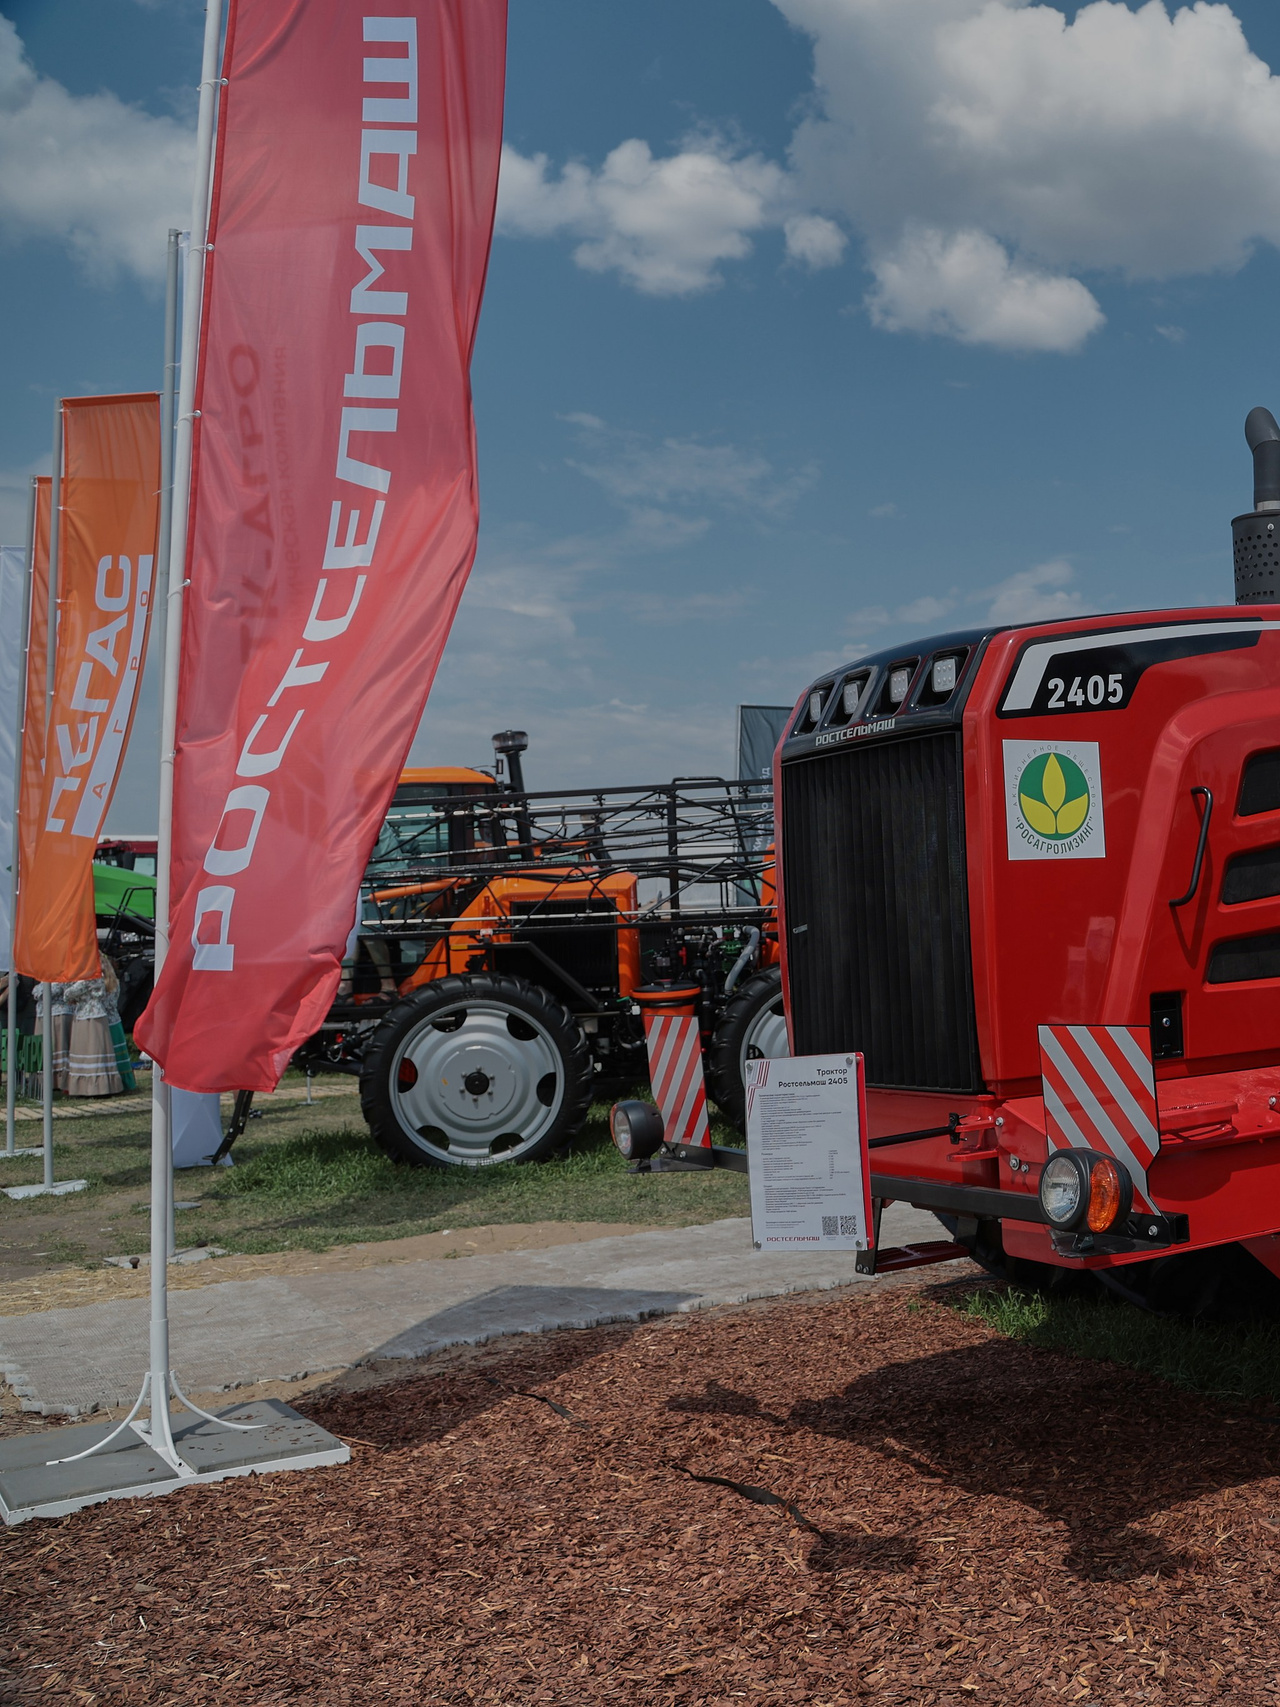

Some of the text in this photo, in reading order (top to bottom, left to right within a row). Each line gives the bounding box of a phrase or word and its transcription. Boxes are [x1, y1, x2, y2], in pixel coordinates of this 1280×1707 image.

[192, 16, 418, 972] РОСТСЕЛЬМАШ
[45, 555, 131, 833] ПЕГАС
[1047, 673, 1123, 709] 2405
[815, 718, 896, 746] РОСТСЕЛЬМАШ
[1012, 745, 1096, 808] АКЦИОНЕРНОЕ ОБЩЕСТВО
[779, 1080, 827, 1088] Ростсельмаш
[817, 1068, 848, 1076] Трактор
